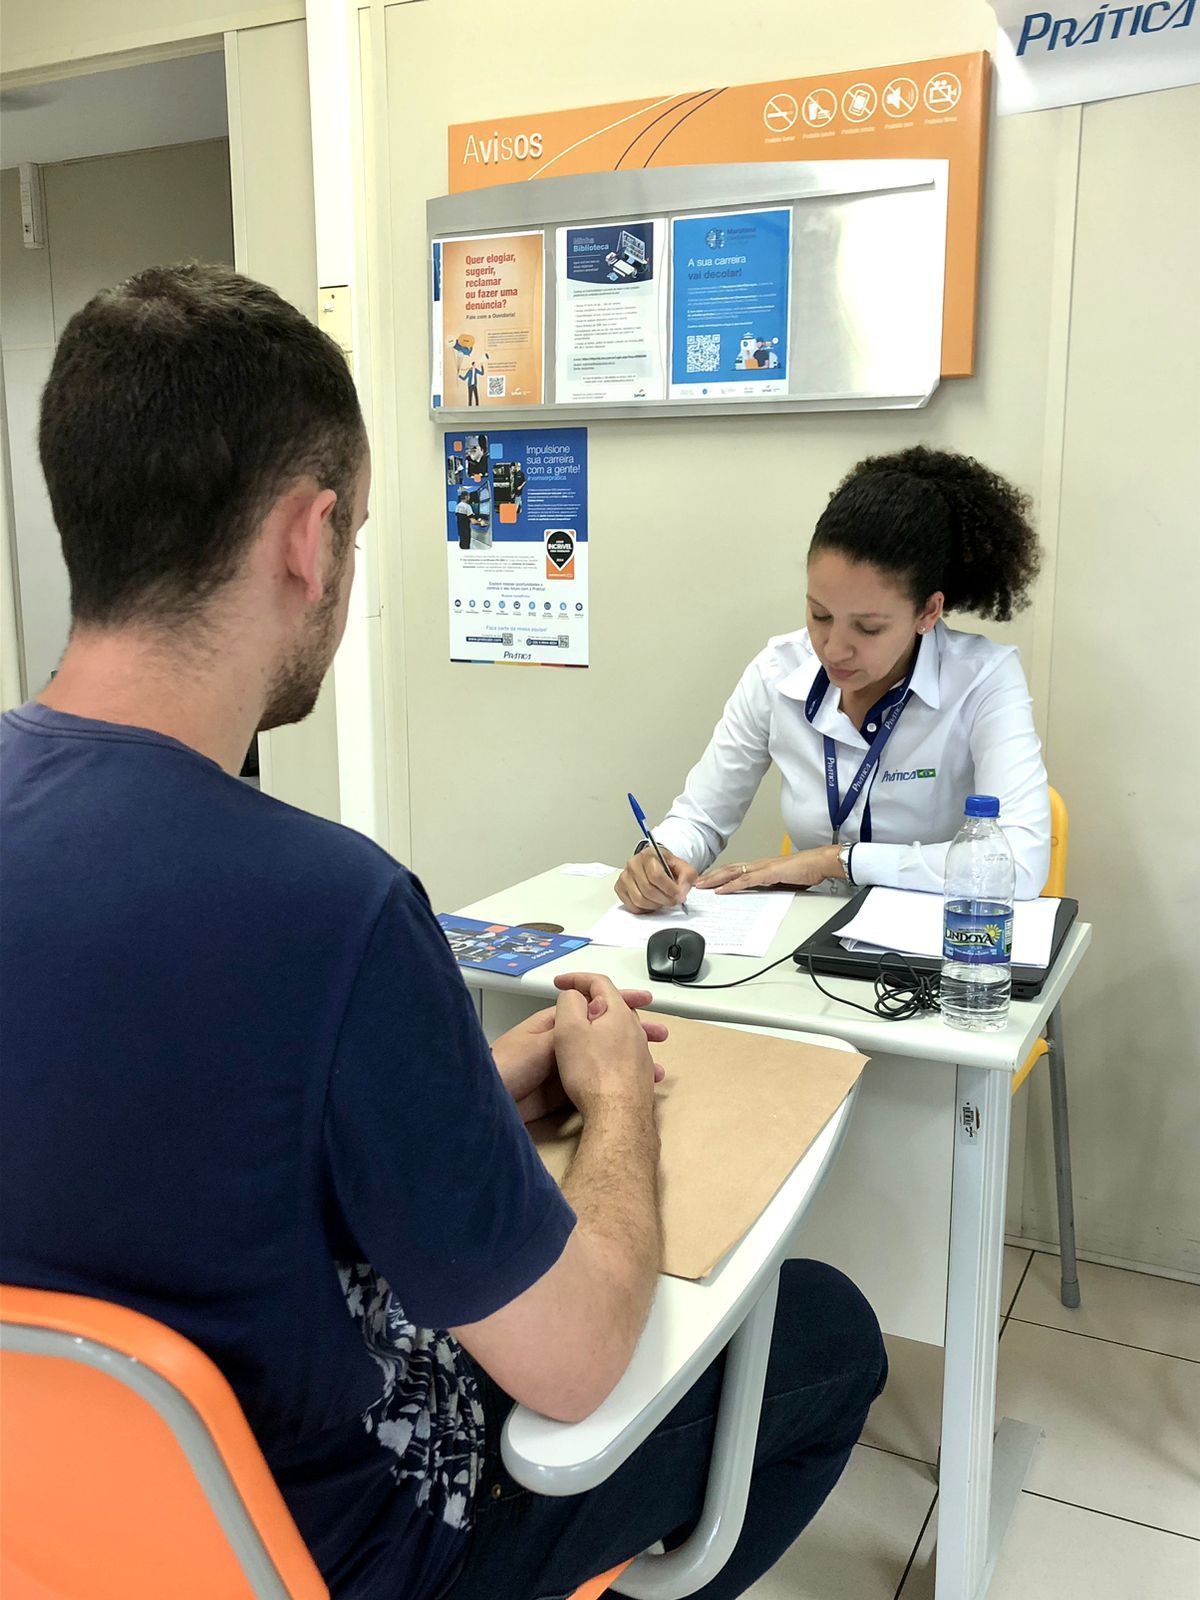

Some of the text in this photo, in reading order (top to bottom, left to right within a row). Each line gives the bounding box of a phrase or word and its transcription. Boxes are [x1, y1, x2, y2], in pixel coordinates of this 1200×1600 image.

[573, 244, 609, 252] Biblioteca
[465, 252, 516, 265] Quer elogiar,
[688, 254, 746, 267] A sua carreira
[465, 265, 496, 277] sugerir,
[688, 268, 742, 280] vai decolar!
[465, 278, 501, 288] reclamar
[465, 288, 518, 299] ou fazer uma
[465, 298, 507, 310] denúncia?
[526, 444, 570, 456] Impulsione
[526, 454, 574, 465] sua carreira
[526, 463, 581, 476] com a gente!
